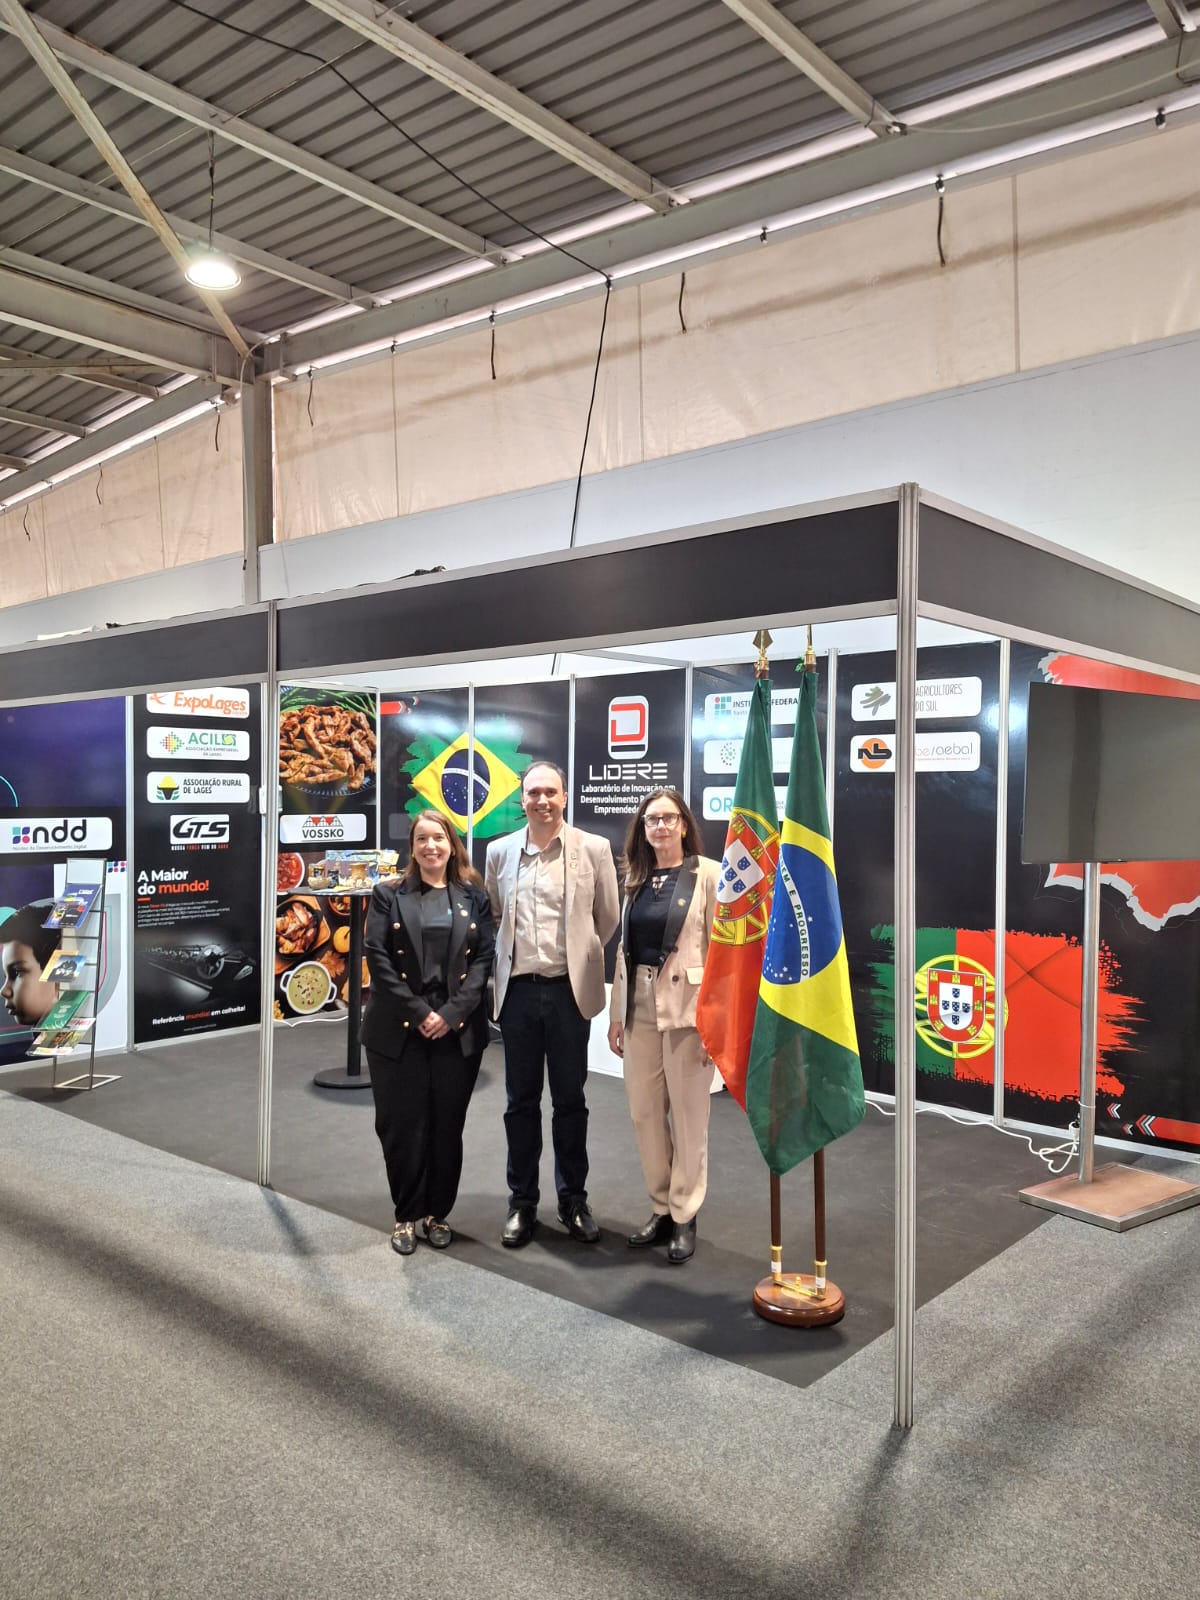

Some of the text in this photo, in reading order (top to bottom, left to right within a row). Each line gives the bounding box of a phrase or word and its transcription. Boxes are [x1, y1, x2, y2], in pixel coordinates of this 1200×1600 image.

[173, 691, 247, 715] ExpoLages
[732, 698, 799, 708] INSTI FEDERA
[925, 700, 939, 711] SUL
[589, 762, 668, 781] LIDERE
[183, 778, 242, 787] ASSOCIAÇÃO RURAL
[581, 783, 620, 793] Laboratório
[621, 783, 631, 793] de
[580, 794, 639, 804] Desenvolvimento
[33, 819, 87, 844] ndd
[173, 816, 229, 838] GTS
[302, 828, 344, 838] VOSSKO
[137, 867, 189, 883] A Maior
[137, 879, 210, 896] do mundo!
[794, 904, 809, 977] PROGRESSO
[152, 1013, 185, 1025] Referência
[211, 1009, 221, 1017] em
